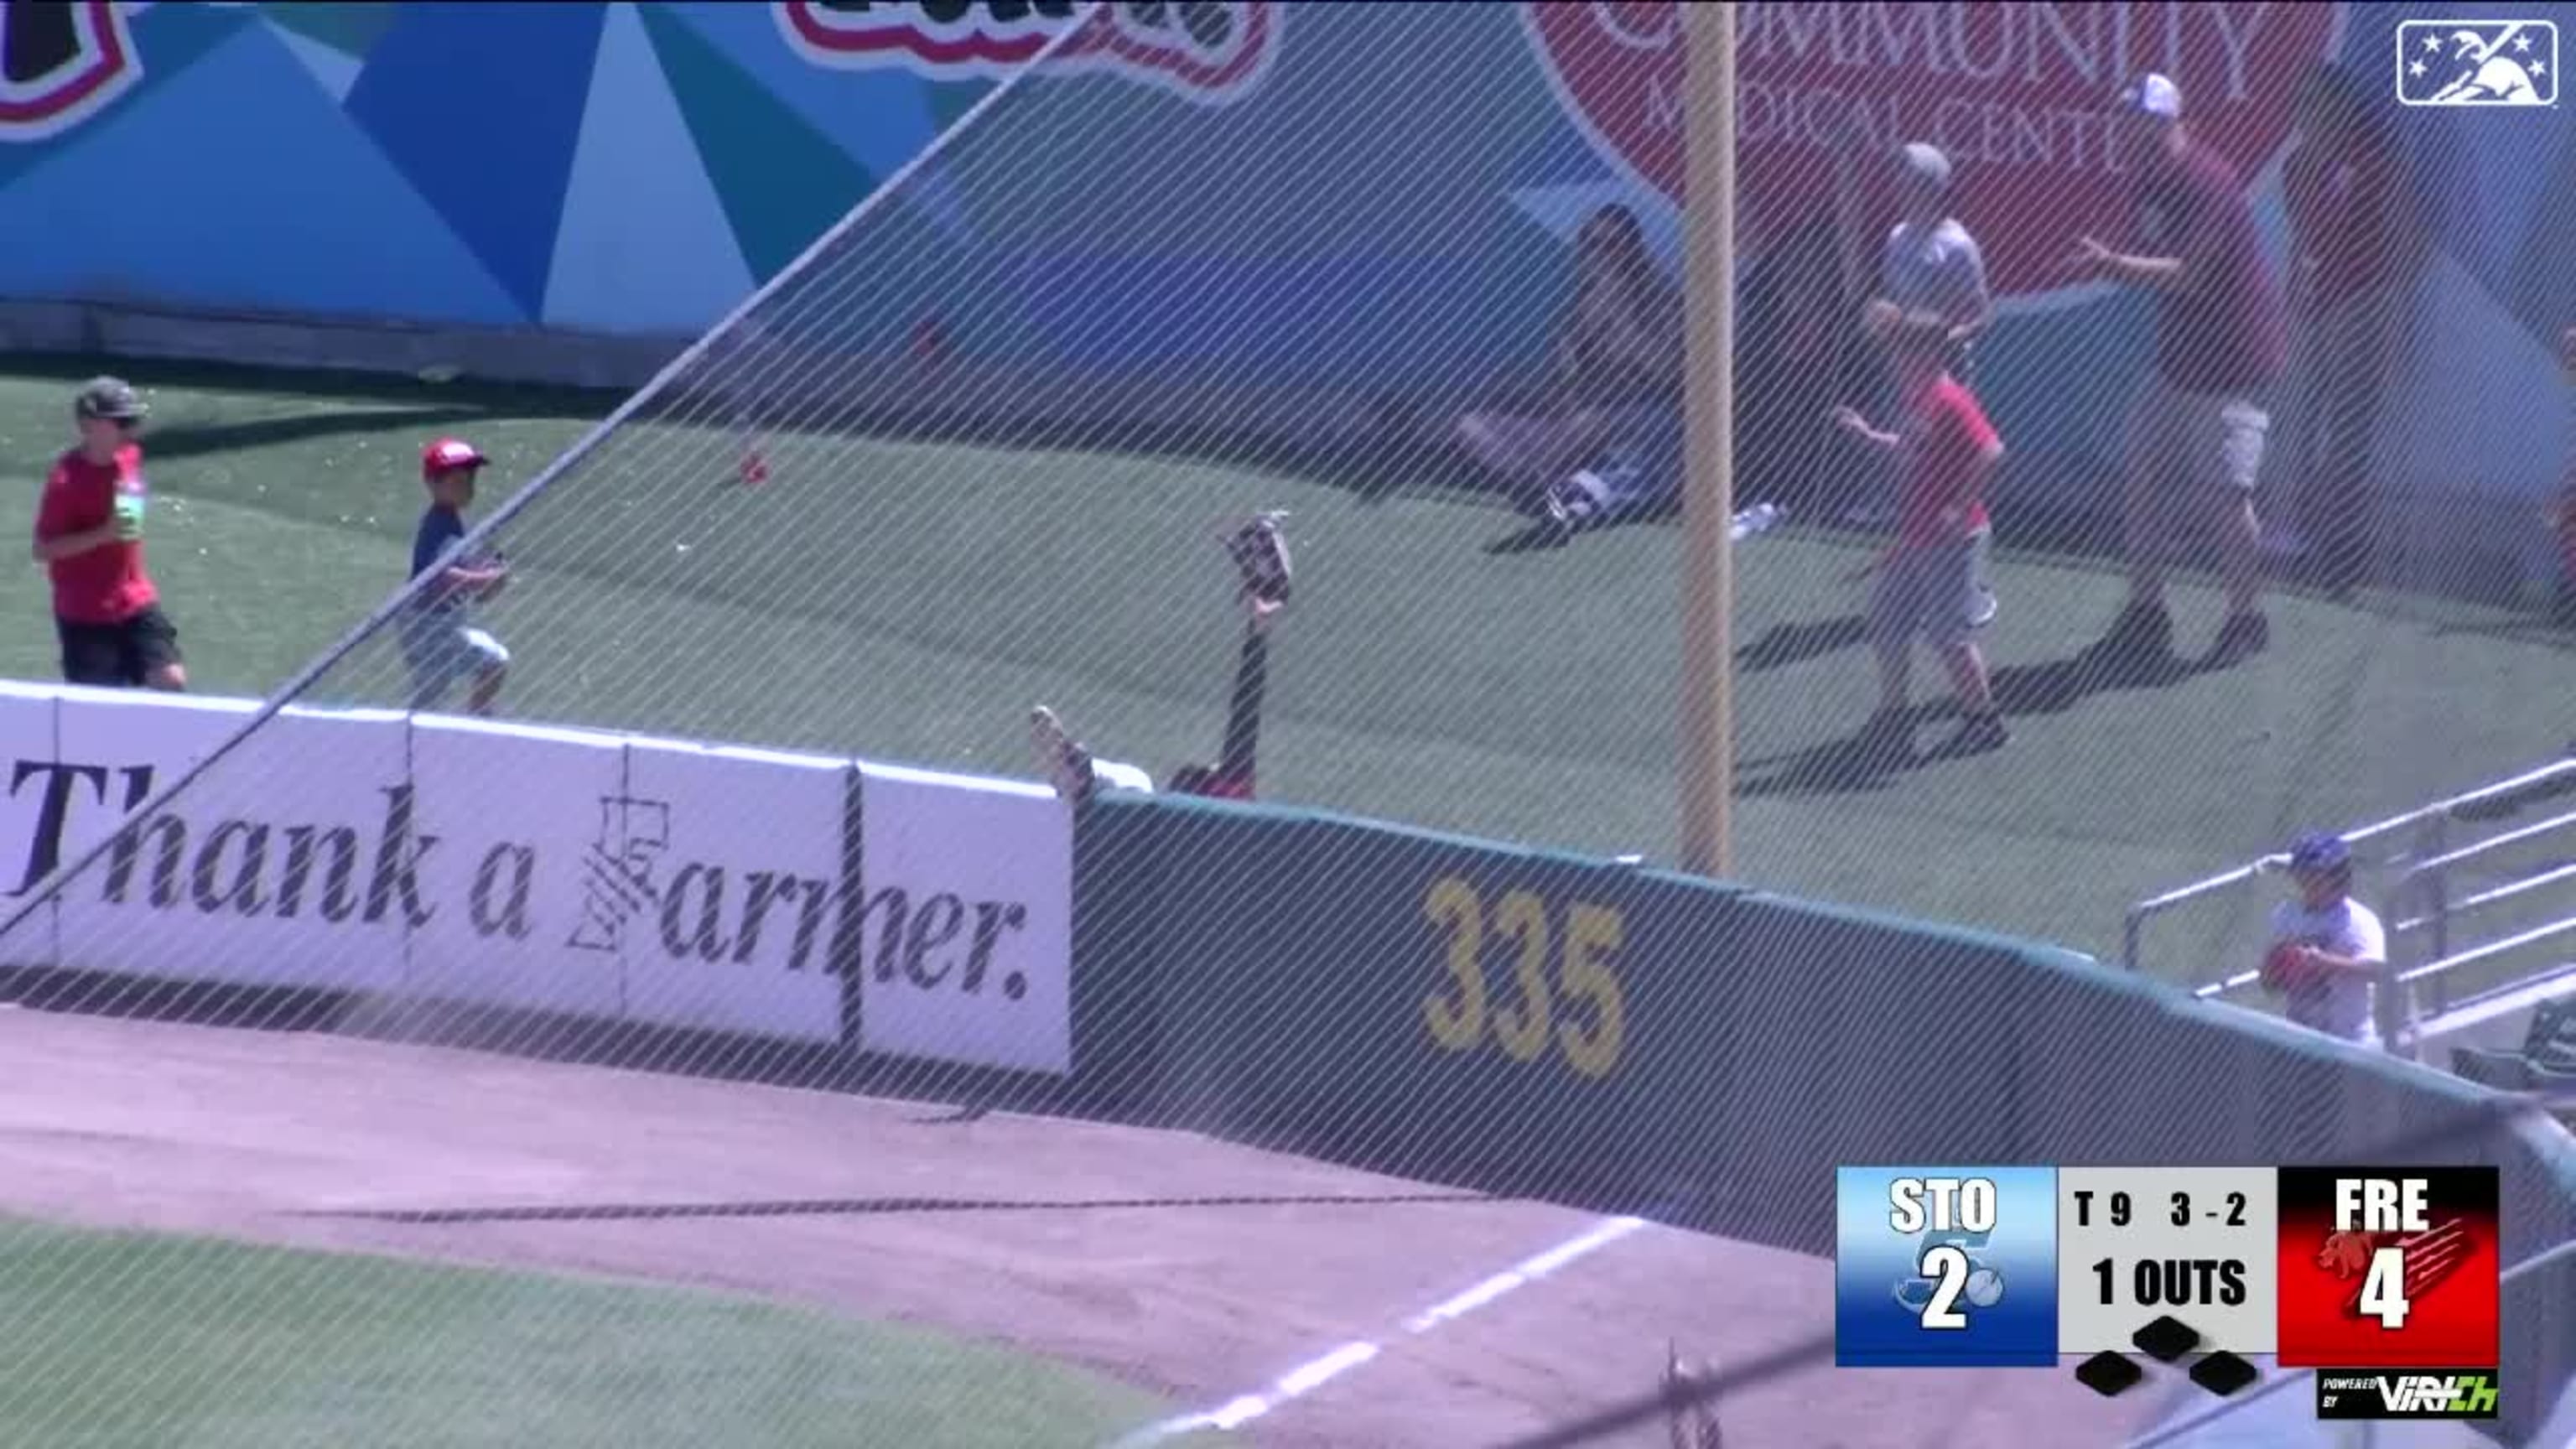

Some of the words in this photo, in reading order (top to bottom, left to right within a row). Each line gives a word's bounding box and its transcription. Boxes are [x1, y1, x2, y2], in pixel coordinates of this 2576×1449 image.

[5, 759, 443, 930] Thank
[468, 840, 537, 941] a
[1424, 875, 1627, 1080] 335
